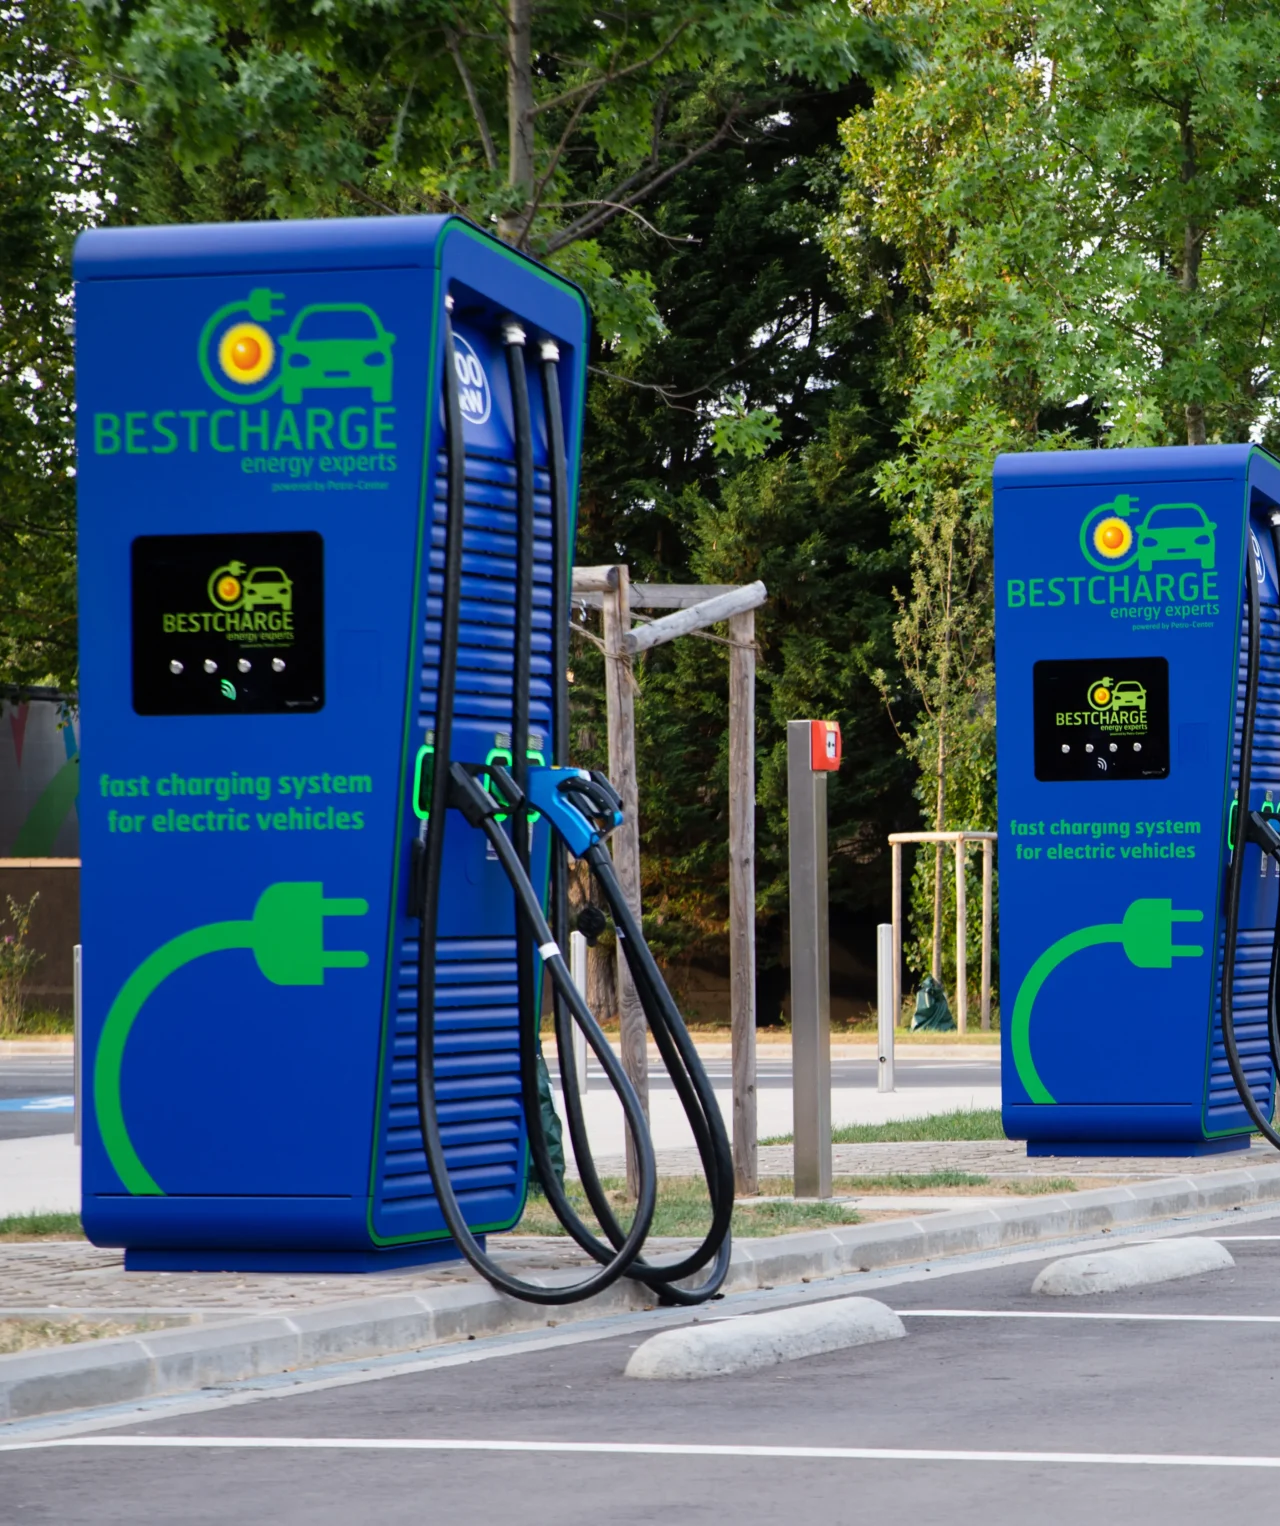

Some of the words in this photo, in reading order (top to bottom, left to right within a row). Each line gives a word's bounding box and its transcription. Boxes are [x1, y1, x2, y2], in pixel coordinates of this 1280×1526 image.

[454, 351, 483, 387] 00
[94, 405, 398, 456] BESTCHARGE
[240, 456, 314, 478] energy
[318, 453, 398, 477] experts
[1007, 571, 1219, 608] BESTCHARGE
[162, 610, 295, 633] BESTCHARGE
[1110, 606, 1161, 621] energy
[1165, 602, 1220, 619] experts
[226, 632, 259, 643] energy
[260, 631, 295, 642] experts
[1132, 622, 1161, 632] powered
[1161, 622, 1170, 630] by
[1171, 620, 1215, 629] Petro-Center
[1056, 710, 1148, 726] BESTCHARGE
[1123, 723, 1148, 731] experts
[99, 774, 150, 798] fast
[156, 772, 271, 801] charging
[278, 771, 373, 800] system
[108, 810, 147, 832] for
[152, 808, 250, 832] electric
[256, 806, 365, 831] vehicles
[1010, 820, 1045, 836] fast
[1050, 818, 1132, 840] charging
[1136, 817, 1202, 838] system
[1016, 843, 1044, 859] for
[1047, 842, 1115, 859] electric
[1120, 841, 1196, 859] vehicles
